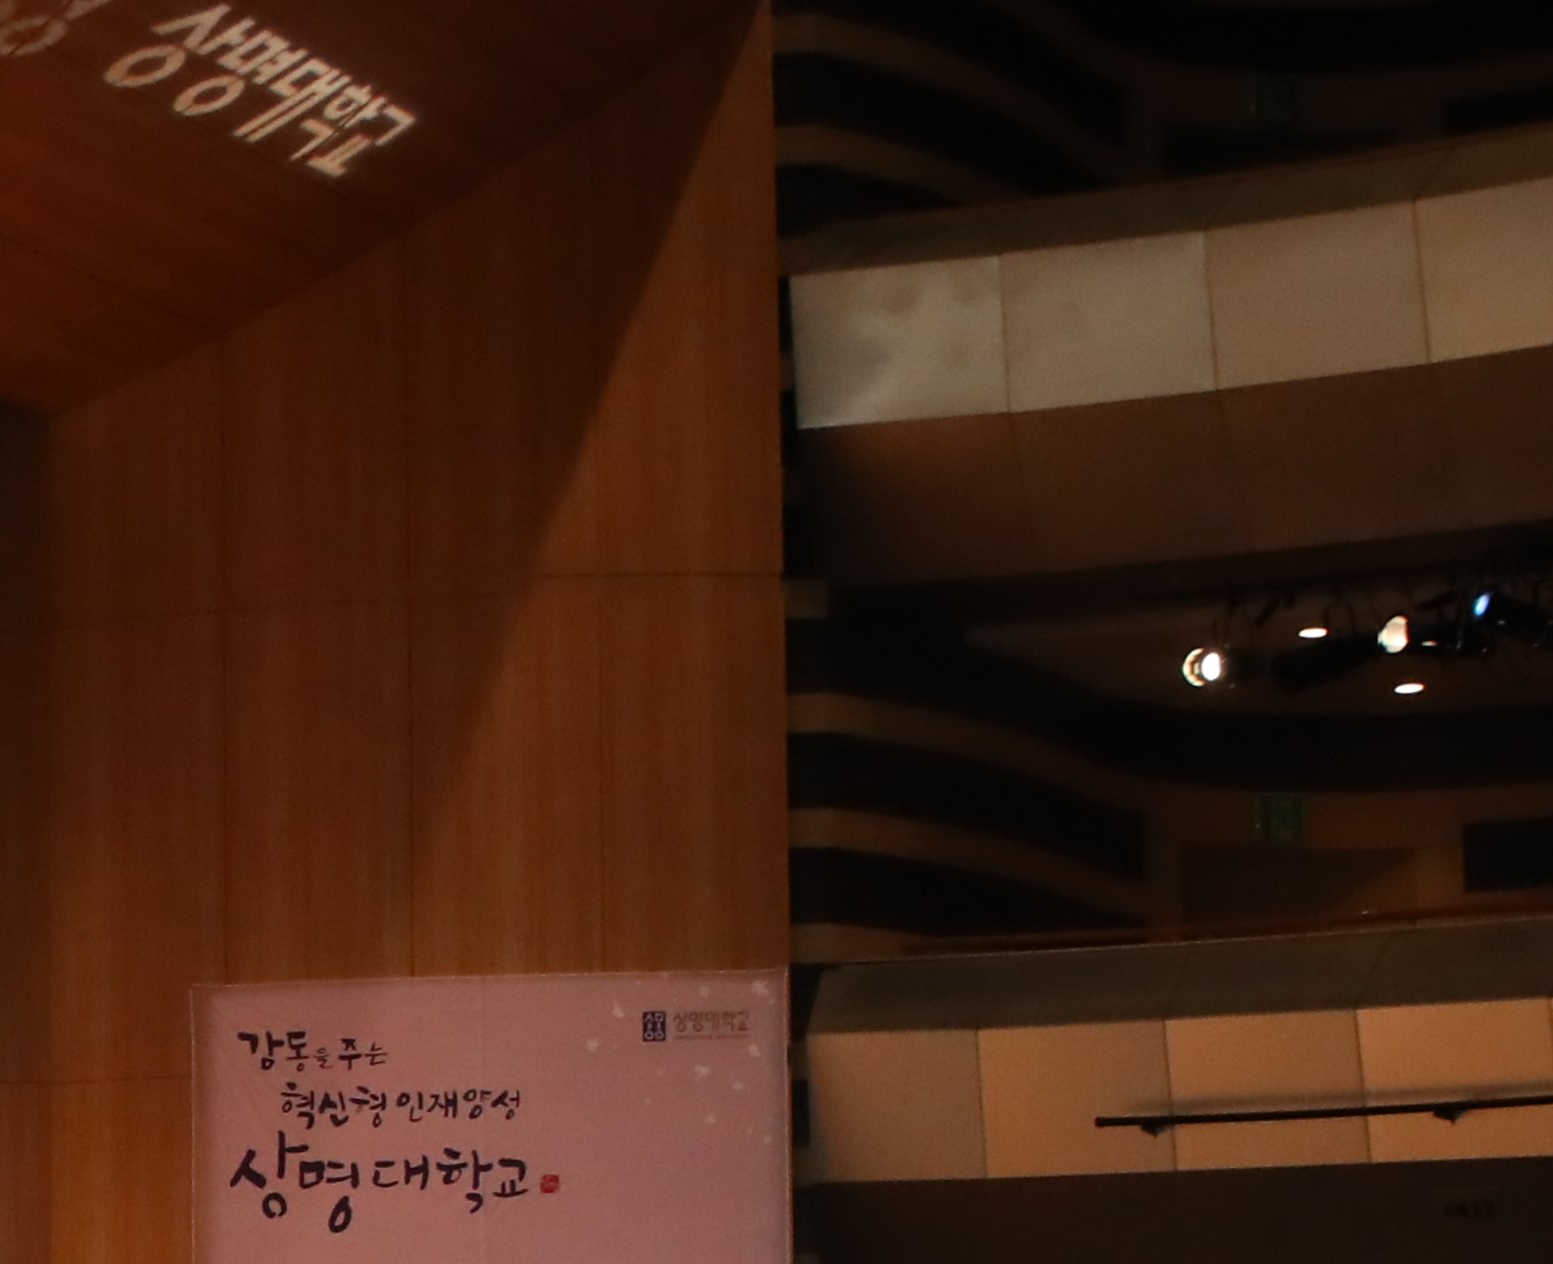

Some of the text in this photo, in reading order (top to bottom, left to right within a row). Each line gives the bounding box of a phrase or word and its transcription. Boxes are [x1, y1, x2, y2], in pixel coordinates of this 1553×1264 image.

[103, 2, 417, 178] 상명대학교
[236, 1030, 388, 1073] 감동을 주는
[280, 1081, 521, 1131] 혁신형 인재양성
[229, 1129, 529, 1234] 상명대학교
